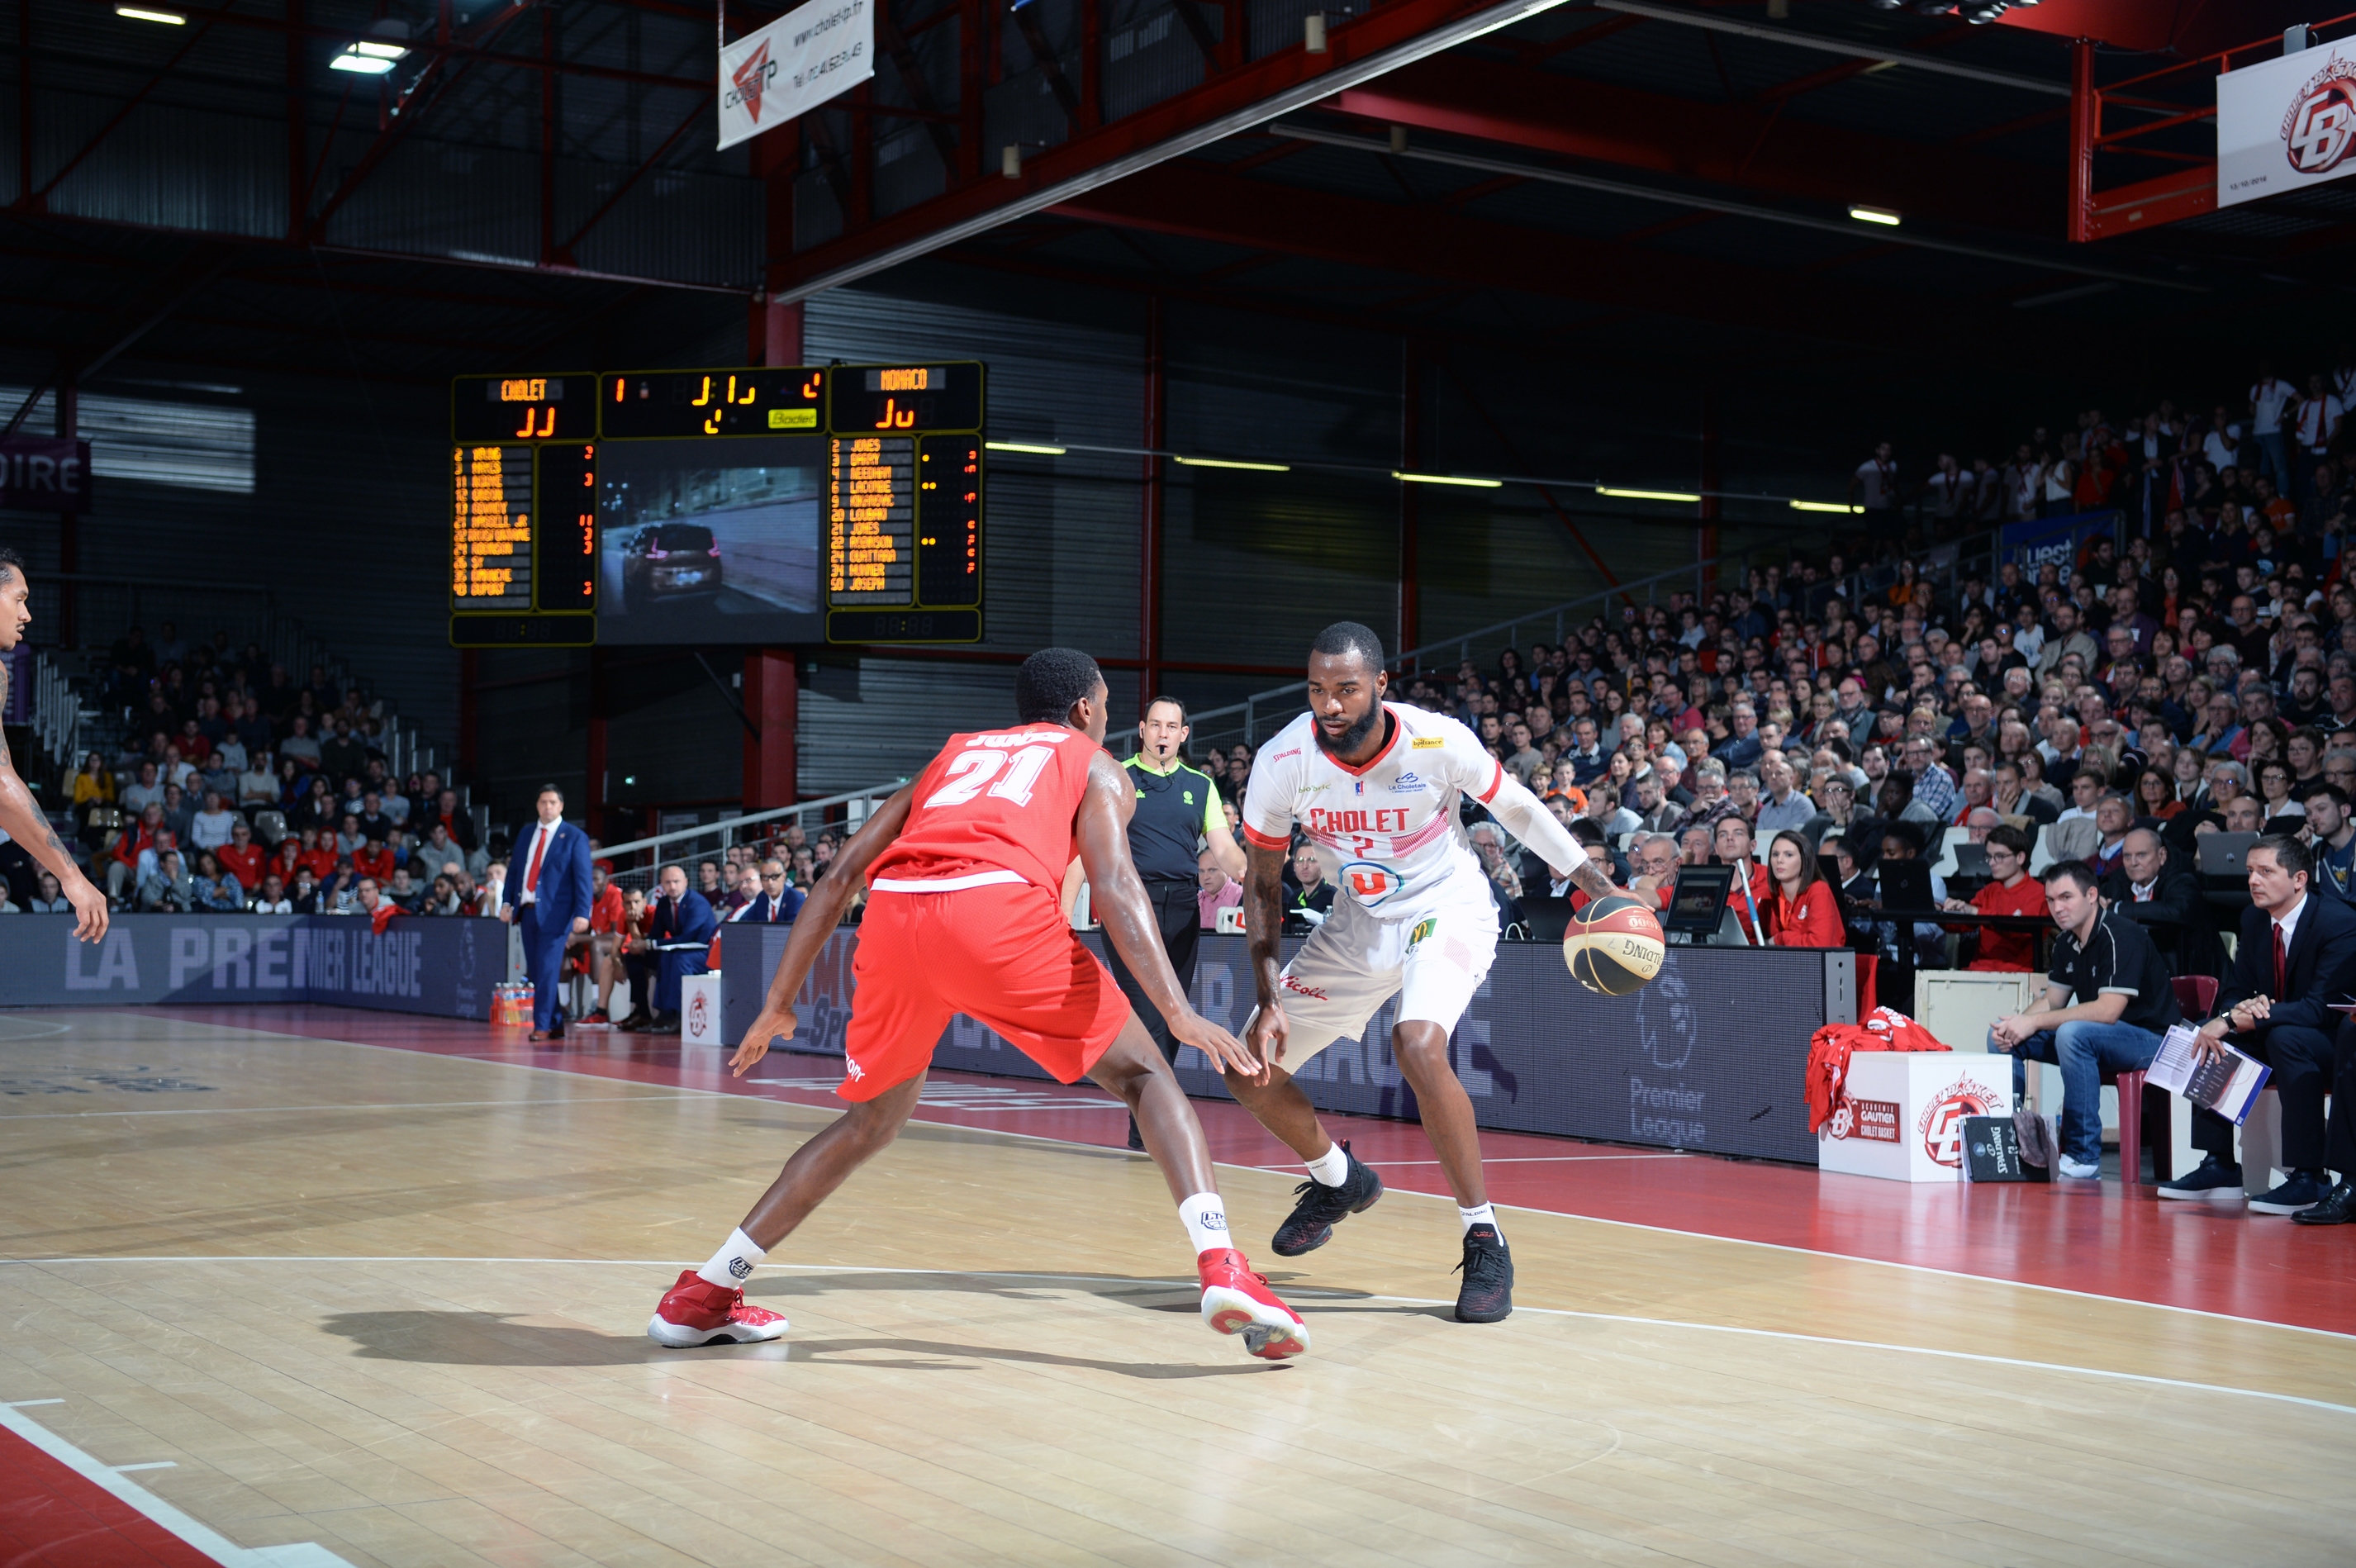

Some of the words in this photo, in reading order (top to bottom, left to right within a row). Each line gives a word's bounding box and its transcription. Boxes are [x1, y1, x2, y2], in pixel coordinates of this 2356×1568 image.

[881, 368, 928, 391] MONACO
[501, 379, 547, 402] CHOLET
[831, 439, 840, 453] 2
[850, 438, 881, 452] JONES
[454, 448, 463, 462] 2
[831, 453, 840, 467] 3
[831, 467, 840, 480] 4
[850, 466, 892, 479] NEEDHAM
[831, 480, 839, 494] 6
[831, 494, 839, 508] 9
[831, 508, 845, 522] 20
[831, 522, 843, 536] 21
[850, 521, 880, 535] JONES
[831, 535, 844, 549] 22
[831, 549, 844, 563] 24
[830, 563, 844, 577] 34
[830, 577, 844, 591] 50
[1413, 739, 1442, 748] bpifrance
[1273, 747, 1302, 763] SPALDING
[923, 745, 1055, 809] 21
[1310, 808, 1409, 833] CHOLET
[1351, 872, 1387, 896] U
[65, 928, 140, 990] LA
[169, 927, 345, 992] PREMIER
[351, 929, 421, 998] LEAGUE
[1632, 1076, 1706, 1111] Premier
[1918, 1090, 1944, 1134] CHOLET
[1945, 1071, 2005, 1109] BASKET
[1860, 1110, 1895, 1124] GAUTIER
[1632, 1108, 1706, 1147] League
[1860, 1124, 1878, 1138] CHOLET
[1878, 1125, 1895, 1140] BASKET
[1990, 1126, 2008, 1174] SPALDING
